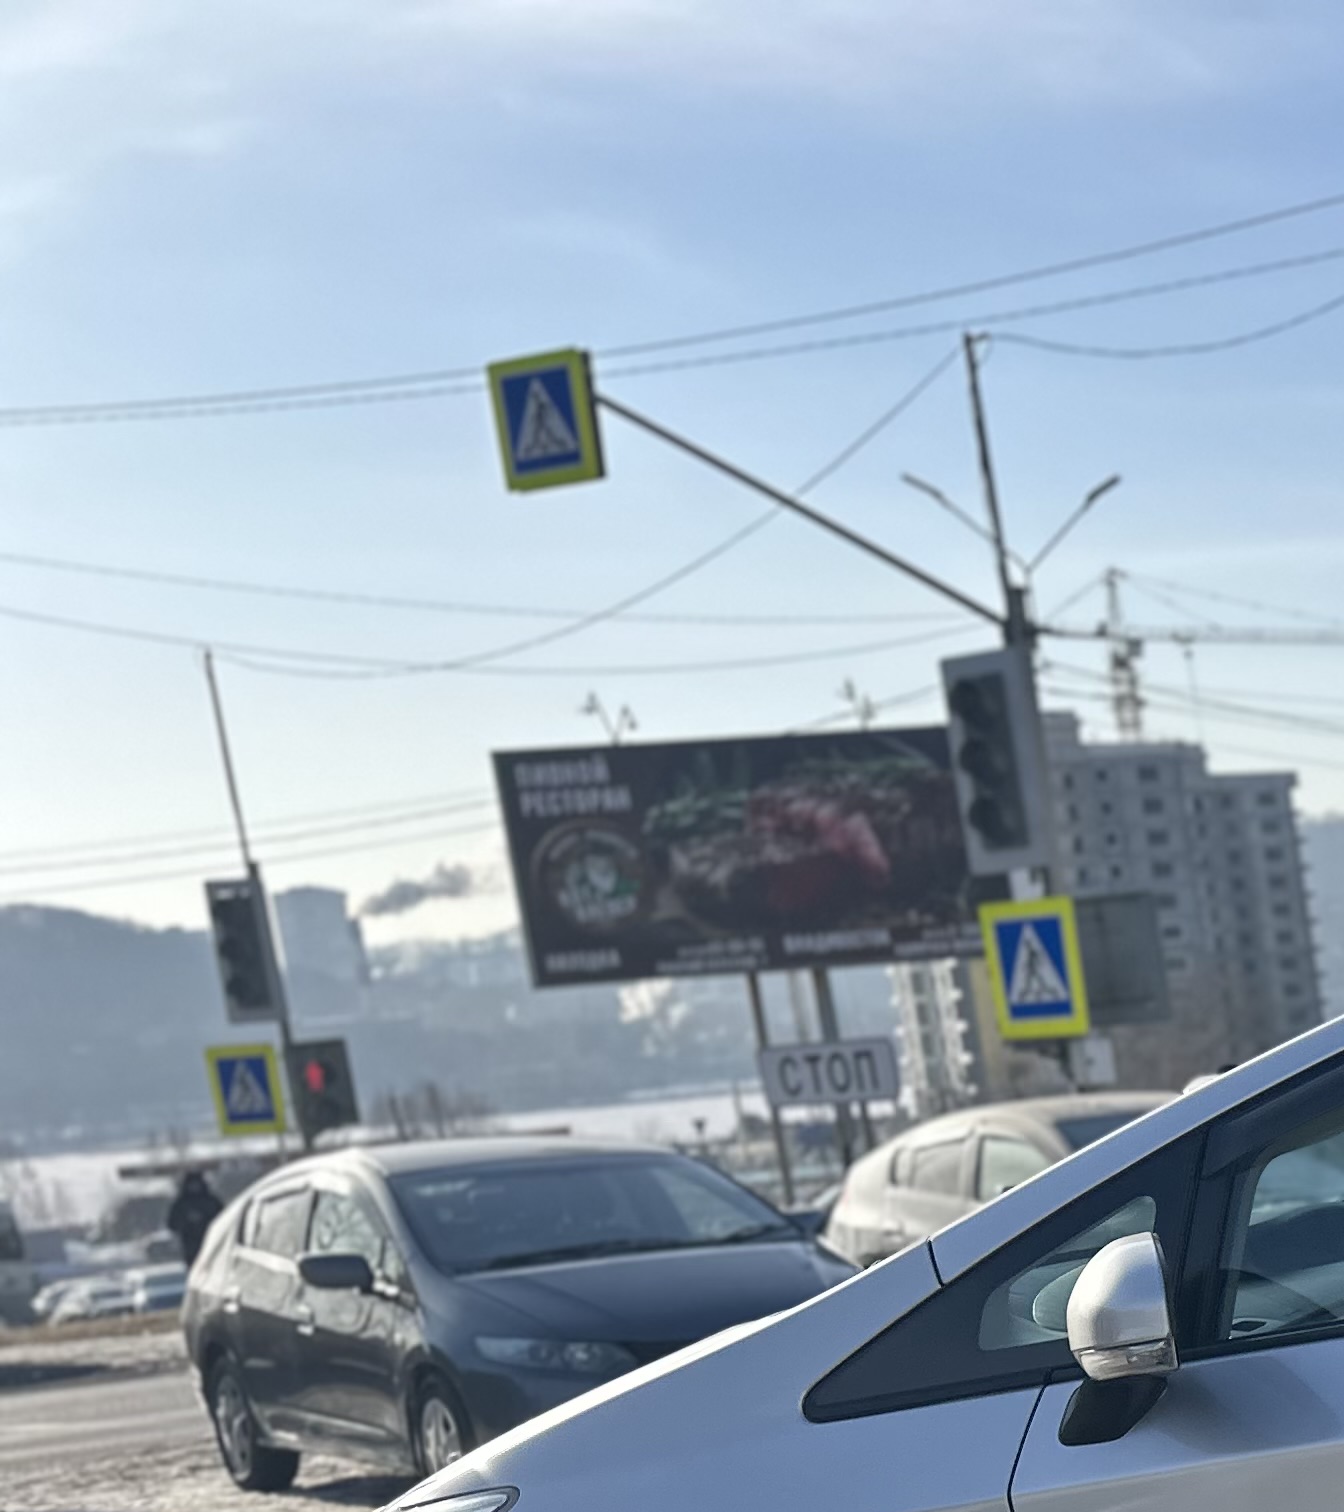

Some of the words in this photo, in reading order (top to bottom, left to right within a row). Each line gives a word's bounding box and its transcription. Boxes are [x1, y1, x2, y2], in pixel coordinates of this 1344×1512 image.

[514, 753, 609, 787] ПИВНОЙ
[521, 786, 631, 816] РЕСТОРАН
[778, 1050, 880, 1096] СТОП
